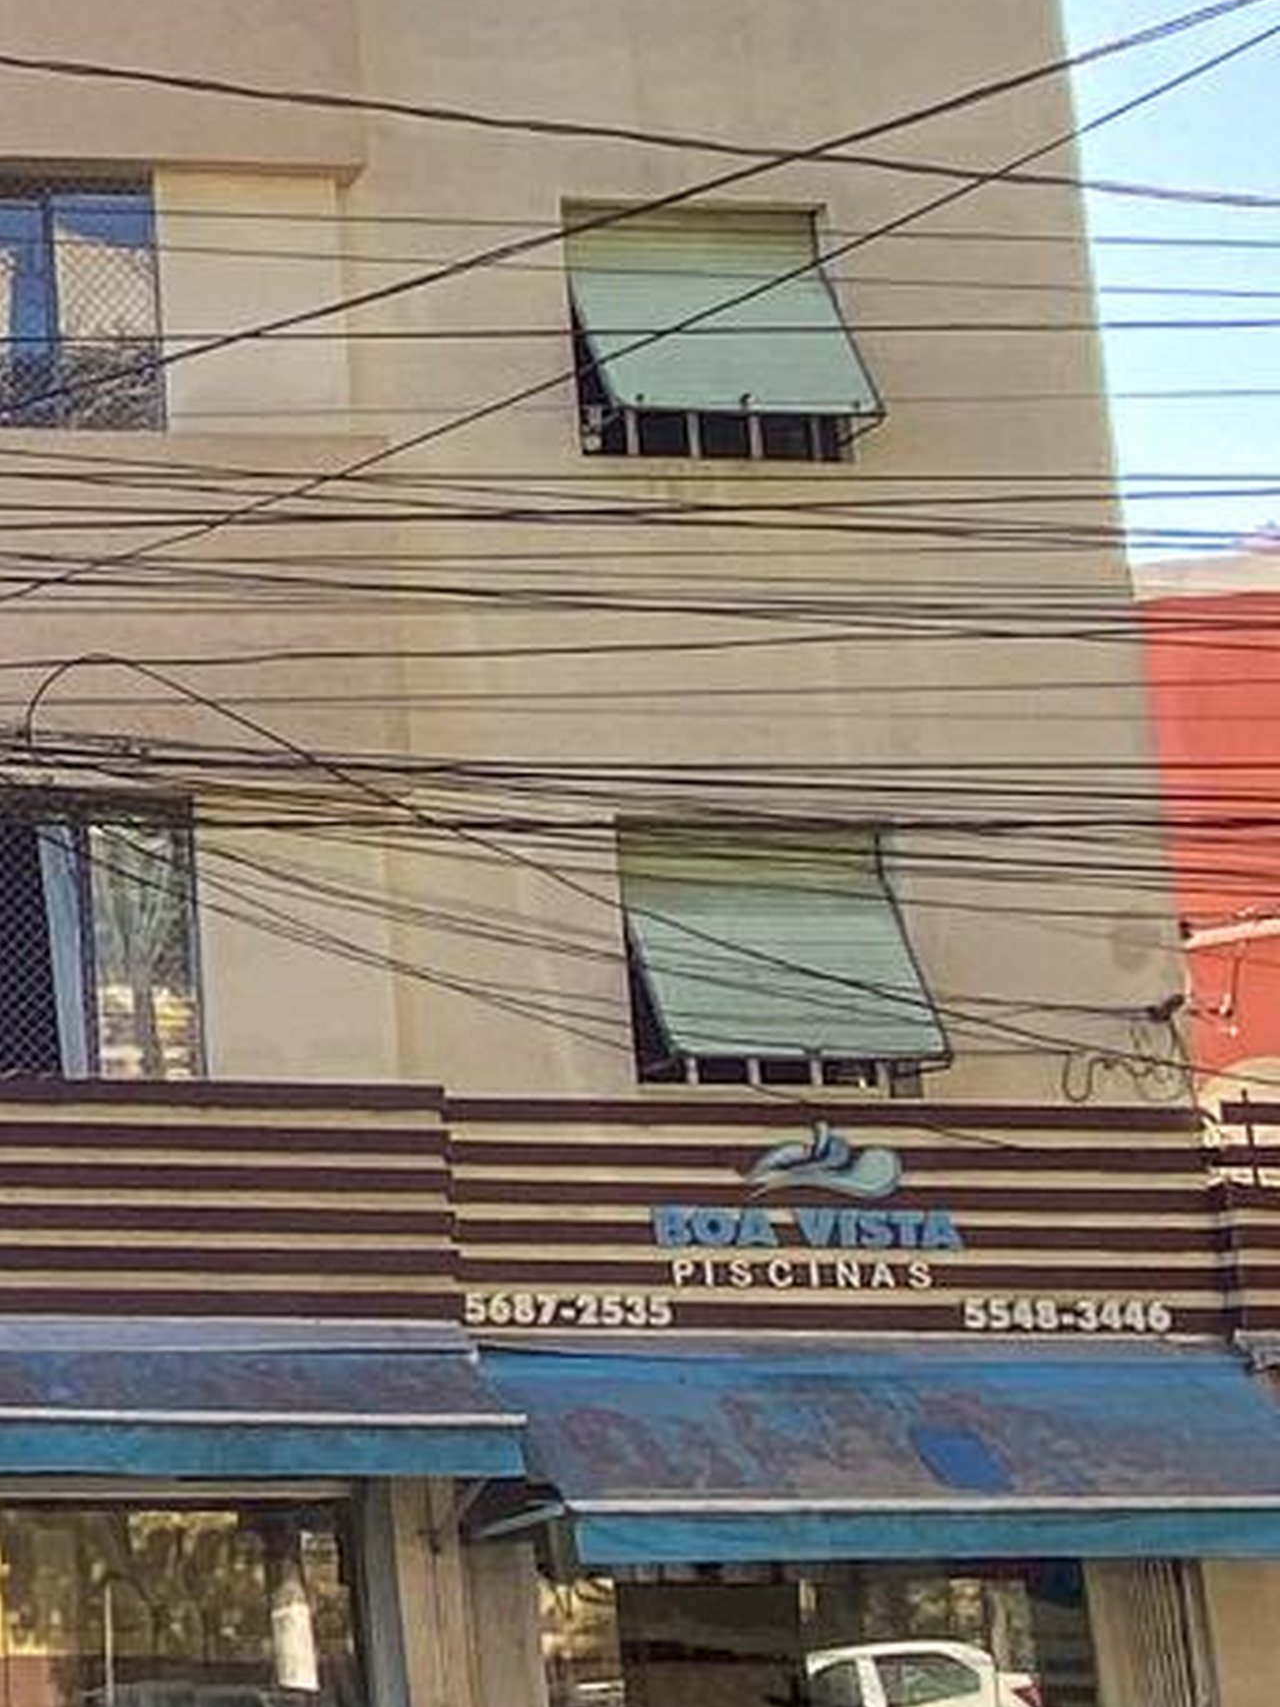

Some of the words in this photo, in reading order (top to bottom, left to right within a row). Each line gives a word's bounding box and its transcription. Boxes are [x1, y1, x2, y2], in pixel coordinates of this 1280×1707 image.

[651, 1205, 778, 1248] BOA
[795, 1207, 966, 1250] VISTA
[671, 1259, 933, 1288] PISCINAS
[464, 1293, 673, 1326] 5687-2535
[964, 1297, 1172, 1331] 5548-3446
